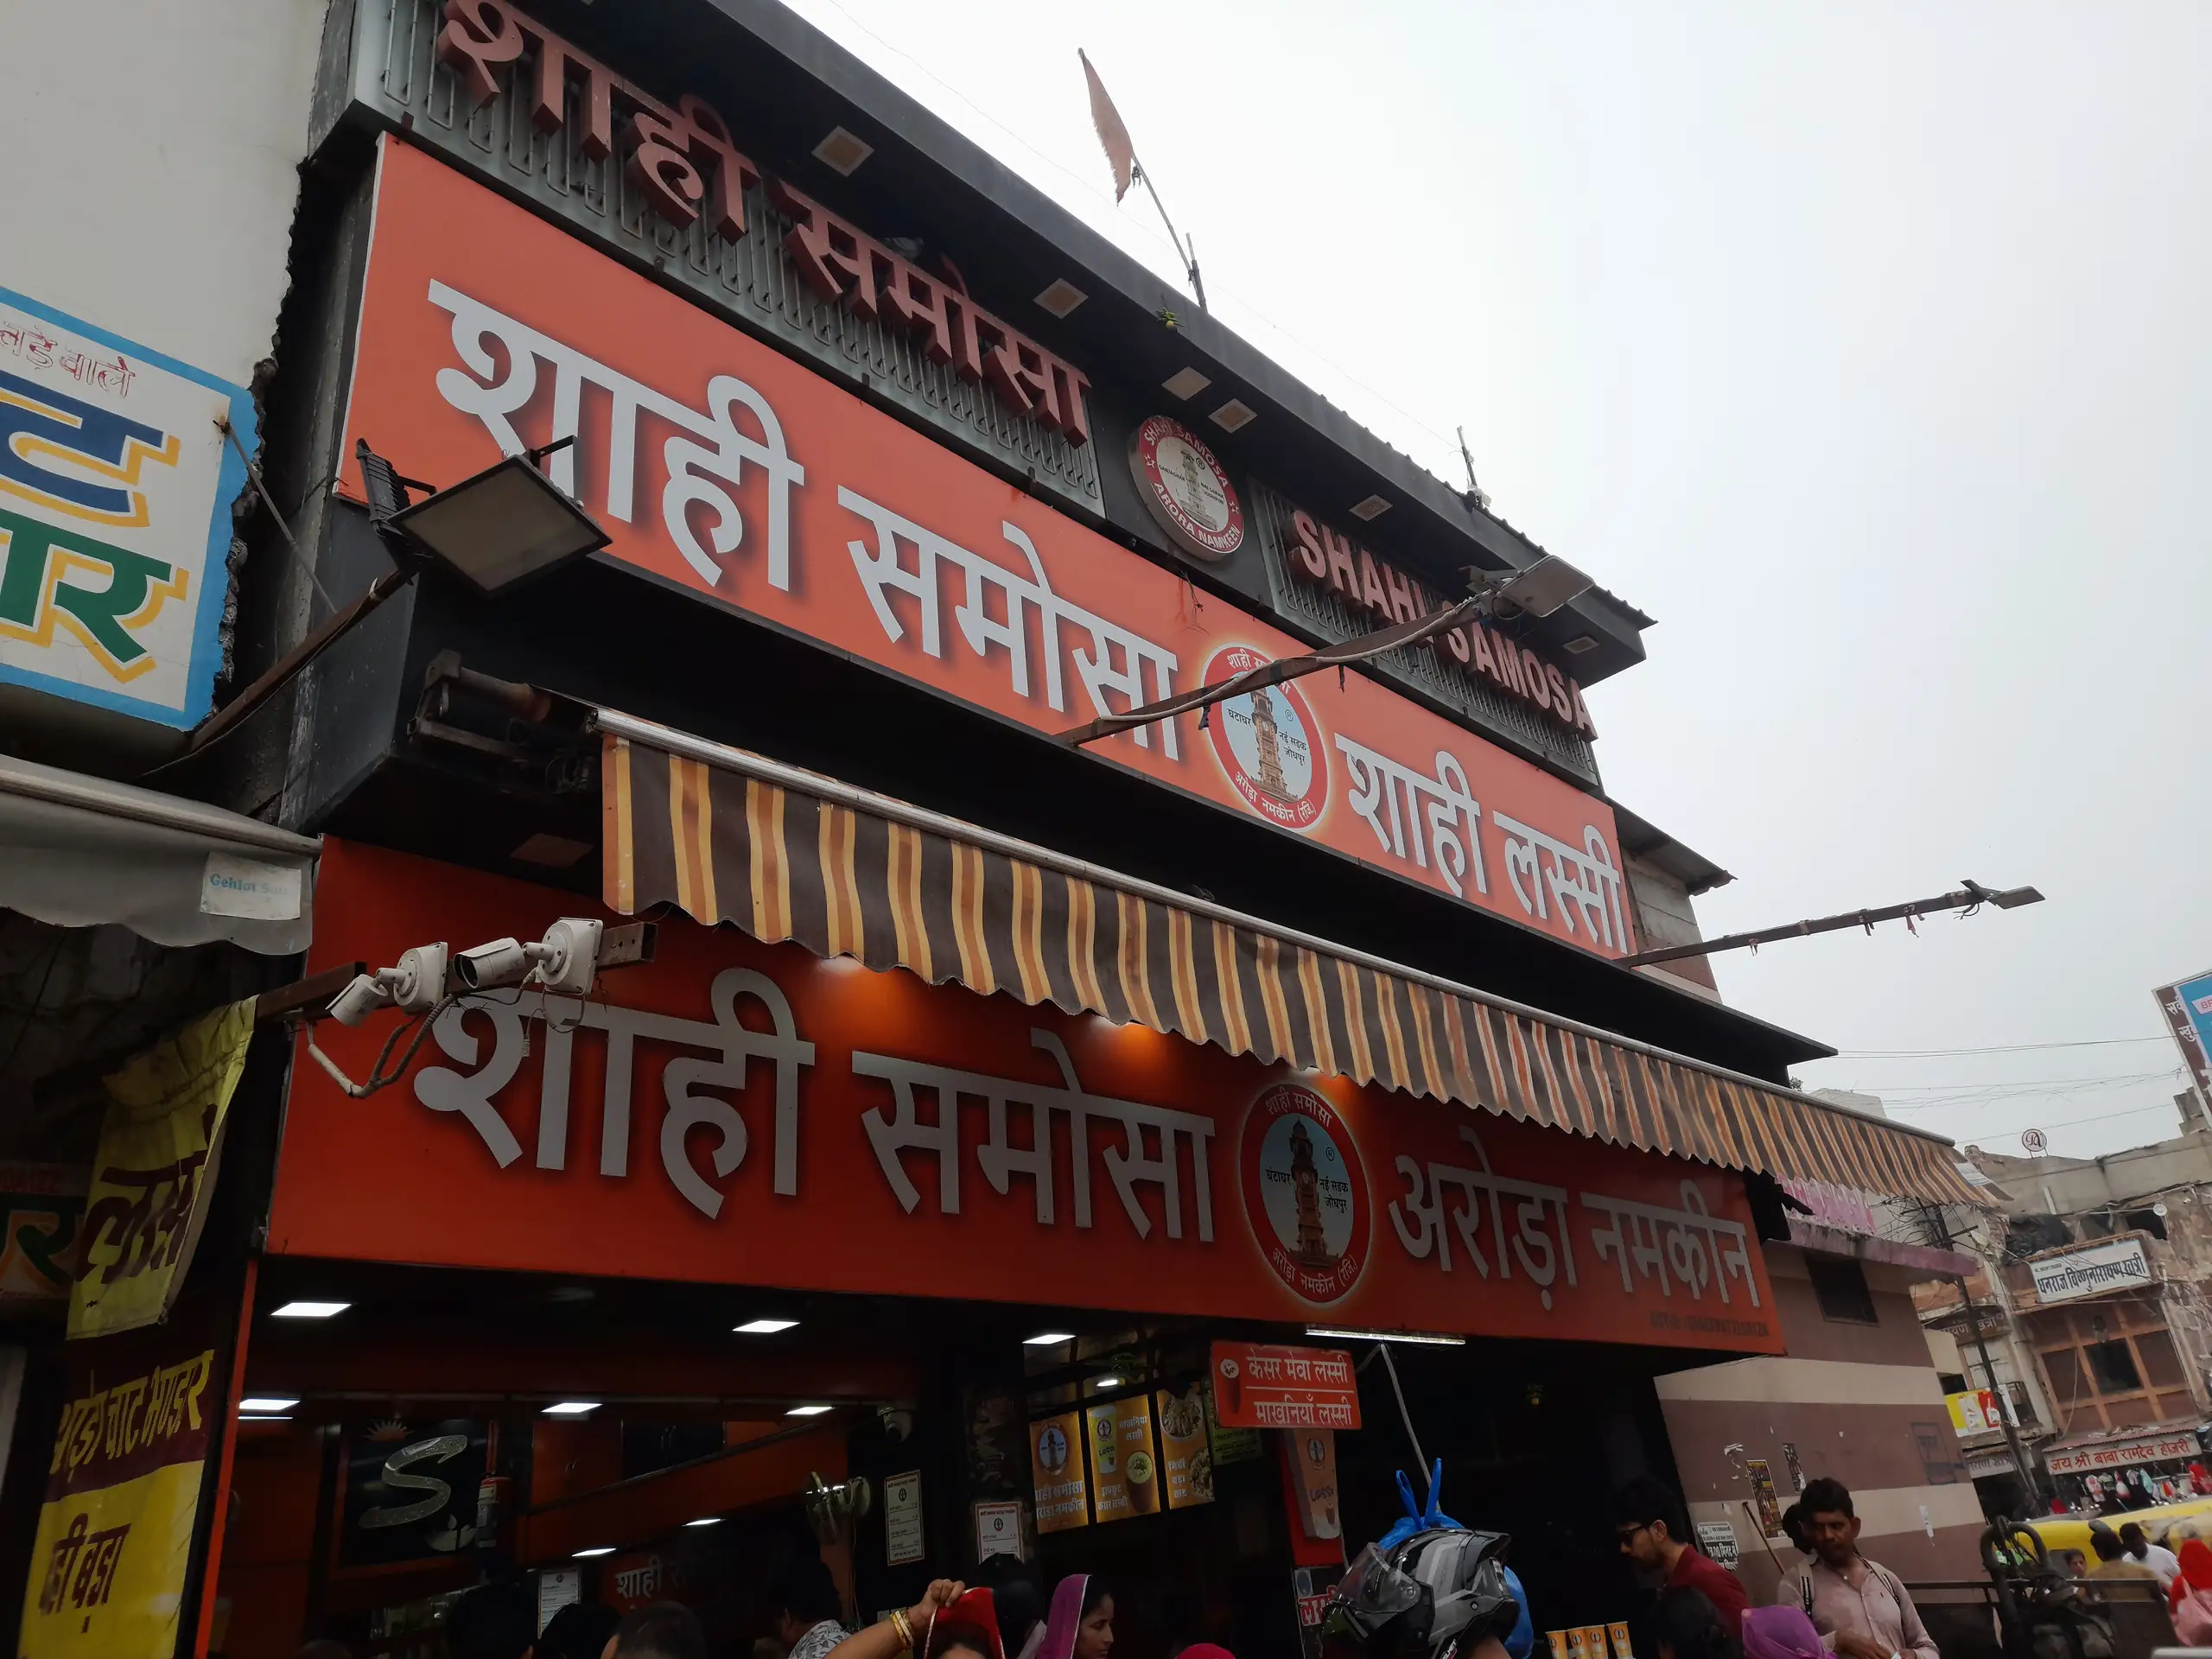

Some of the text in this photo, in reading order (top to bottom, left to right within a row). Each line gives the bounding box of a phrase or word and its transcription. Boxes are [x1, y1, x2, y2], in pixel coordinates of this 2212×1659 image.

[438, 0, 1091, 448] शाही समोसा
[1144, 420, 1229, 488] SHAHI SAMOSA
[428, 278, 1179, 761] शाही समोसा
[1154, 481, 1241, 550] ARORA NAMKEEN
[1289, 510, 1599, 742] SHAHI SAMOSA
[1228, 648, 1250, 669] शाही
[1227, 707, 1252, 728] घंटाघर
[1279, 731, 1307, 752] नई सड़क
[1283, 746, 1306, 766] जोधपुर
[1235, 771, 1258, 803] अरोड़ा
[1262, 798, 1296, 823] नमकीन
[1334, 733, 1628, 954] शाही लस्सी
[414, 968, 1215, 1243] शाही समोसा
[1265, 1086, 1332, 1128] शाही समोसा
[1265, 1167, 1292, 1185] घंटाघर
[1319, 1177, 1349, 1196] नई सड़क
[1324, 1194, 1348, 1214] जोधपुर
[1389, 1125, 1760, 1310] अरोड़ा नमकीन
[1273, 1246, 1296, 1283] अरोड़ा
[1300, 1270, 1337, 1295] नमकीन
[2037, 1271, 2069, 1294] धनराज
[1246, 1347, 1348, 1384] केसर मेवा लस्सी
[105, 1376, 149, 1460] चाट
[1254, 1392, 1352, 1426] माखनियाँ लस्सी
[2050, 1457, 2072, 1471] जय
[2075, 1451, 2092, 1468] श्री
[2119, 1444, 2155, 1461] रामदेव
[2157, 1438, 2190, 1457] होजरी
[614, 1554, 664, 1599] शाही
